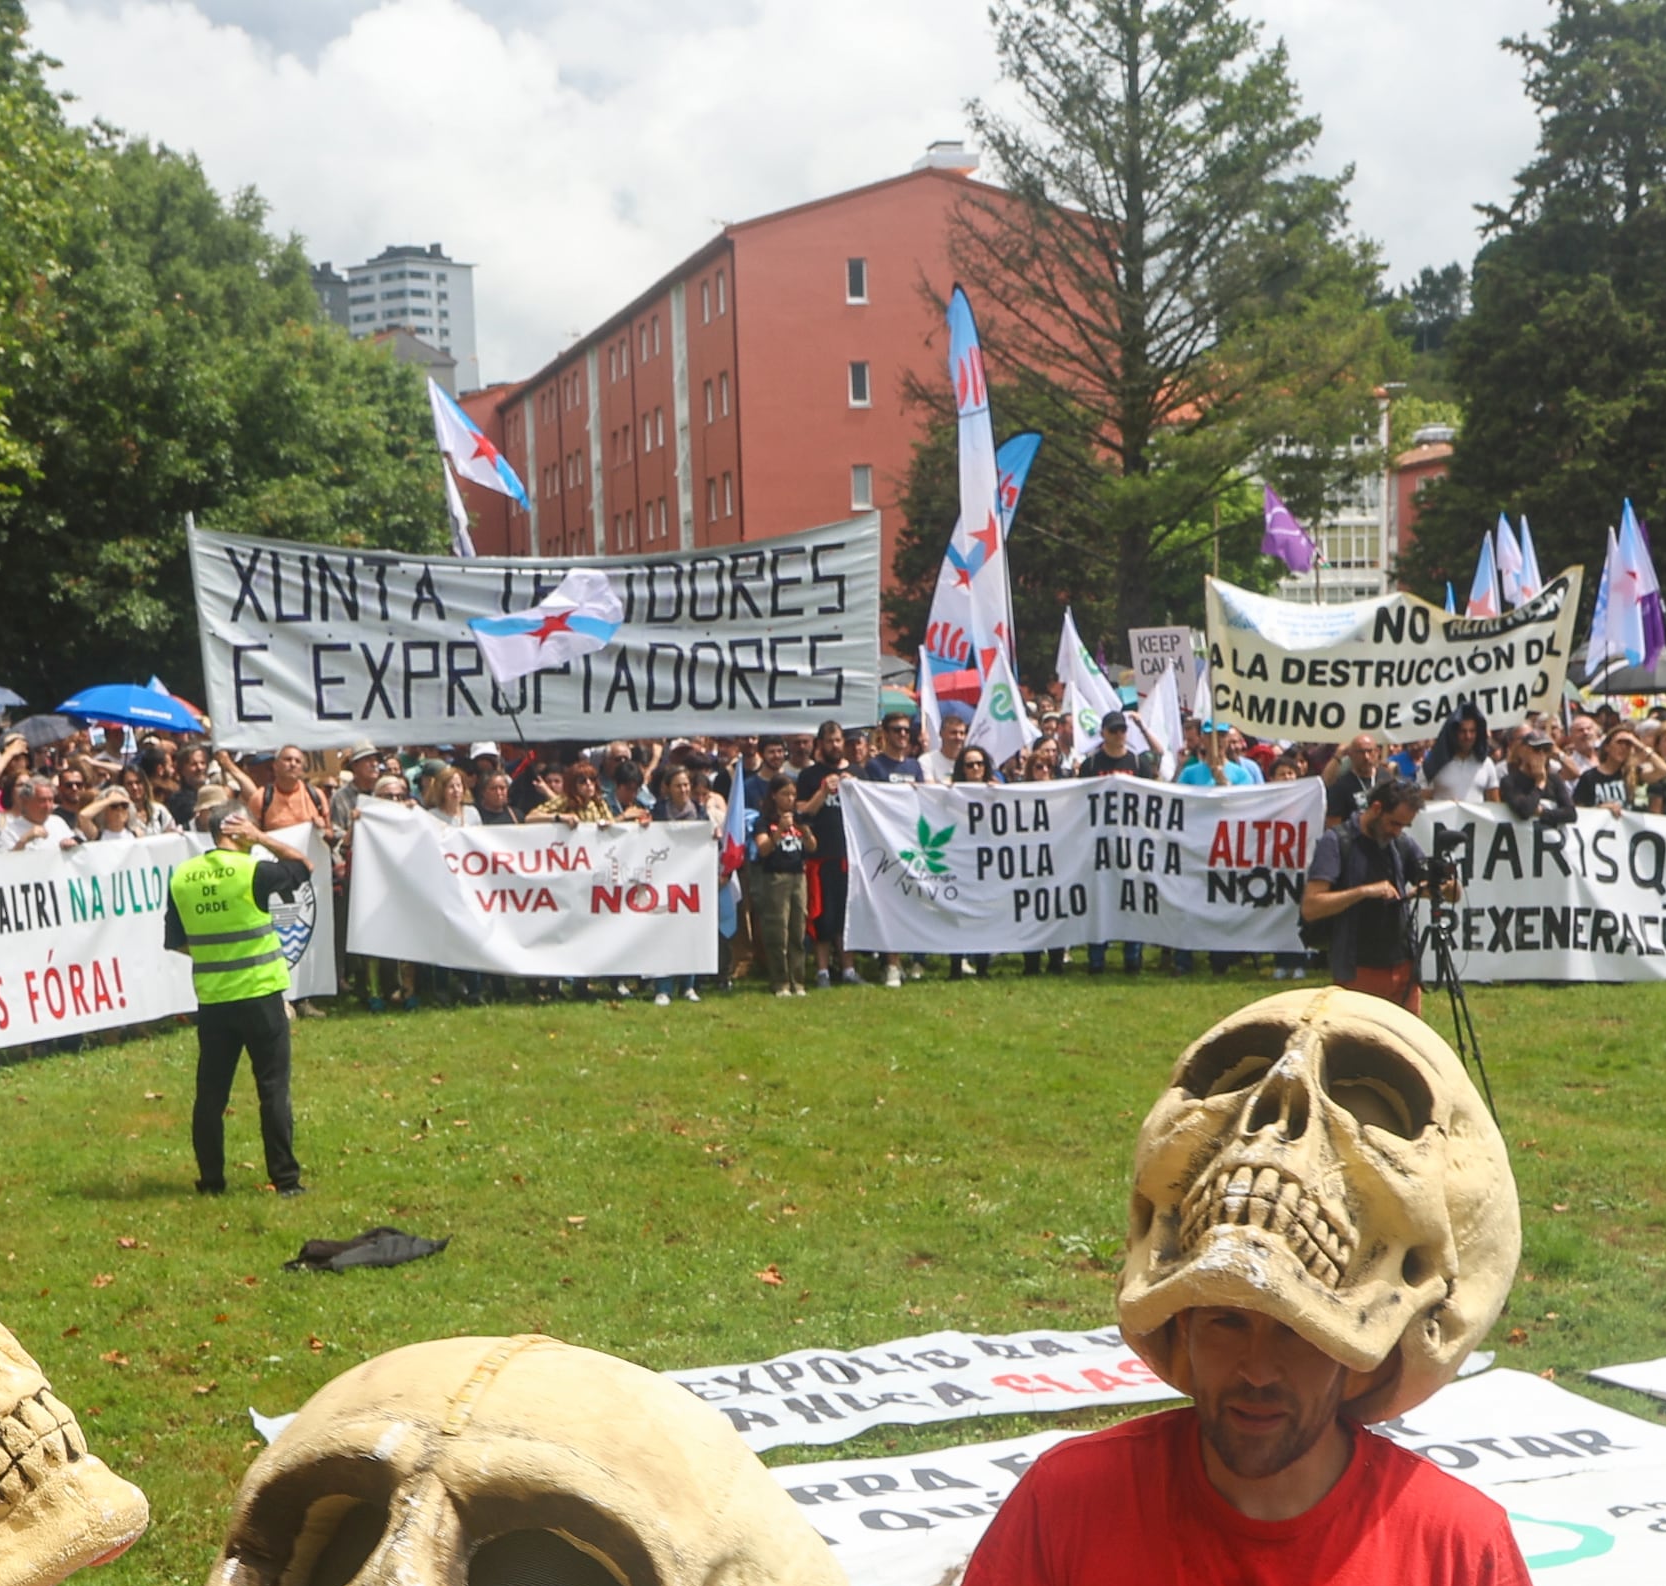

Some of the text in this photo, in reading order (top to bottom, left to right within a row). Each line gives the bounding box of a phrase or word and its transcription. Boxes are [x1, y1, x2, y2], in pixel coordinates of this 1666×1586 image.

[225, 546, 446, 623] XUNTA
[1137, 634, 1181, 654] KEEP
[1373, 605, 1430, 645] NO
[232, 644, 274, 722] E
[1232, 647, 1269, 682] LA
[1280, 642, 1515, 688] DESTRUCCIÓN
[1212, 684, 1346, 730] CAMINO
[1357, 701, 1403, 731] DE
[968, 790, 1184, 836] POLA TERRA
[445, 840, 592, 875] CORUÑA
[976, 842, 1055, 880] POLA
[1094, 836, 1182, 876] AUGA
[1207, 820, 1309, 869] ALTRI
[185, 867, 236, 883] SERVIZO
[201, 884, 218, 897] DE
[1207, 866, 1305, 908] NON
[70, 877, 106, 922] NA
[195, 901, 230, 916] ORDE
[475, 882, 700, 914] VIVA NON
[1014, 878, 1158, 923] POLO AR
[23, 949, 128, 1024] FÓRA!
[676, 1347, 973, 1402] EXPOLIO
